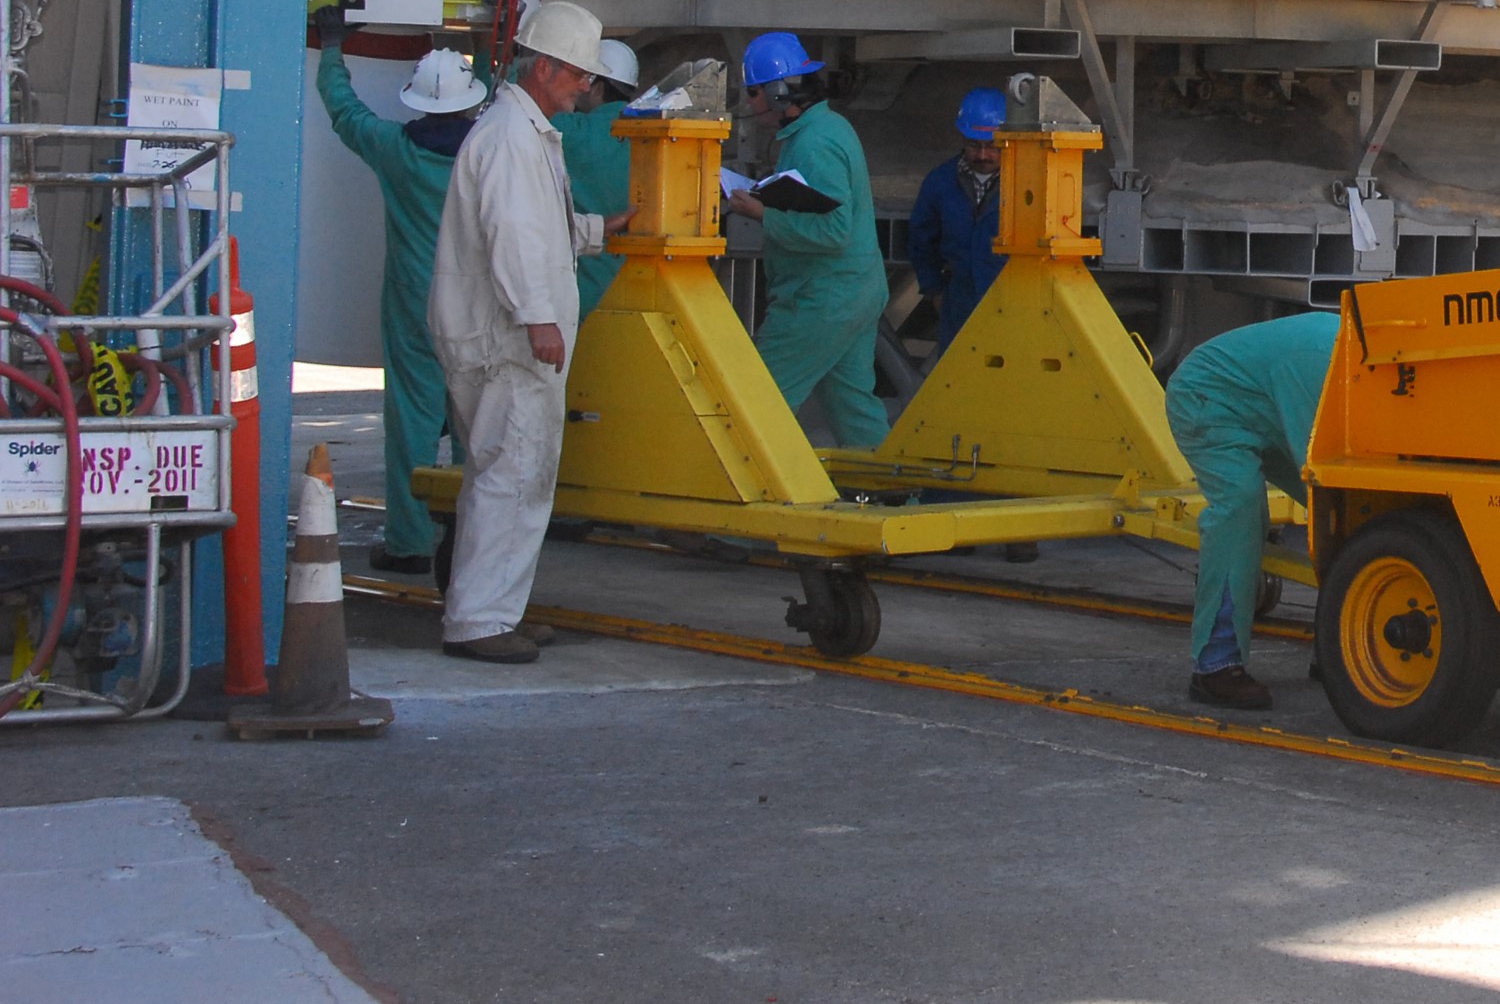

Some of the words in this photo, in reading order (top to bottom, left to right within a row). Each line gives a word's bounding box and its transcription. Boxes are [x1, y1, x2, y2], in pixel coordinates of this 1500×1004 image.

[144, 95, 167, 104] WET
[169, 97, 200, 107] PAINT
[162, 119, 178, 128] ON
[8, 441, 60, 458] Spider
[82, 447, 141, 471] NSP.
[156, 445, 203, 469] DUE
